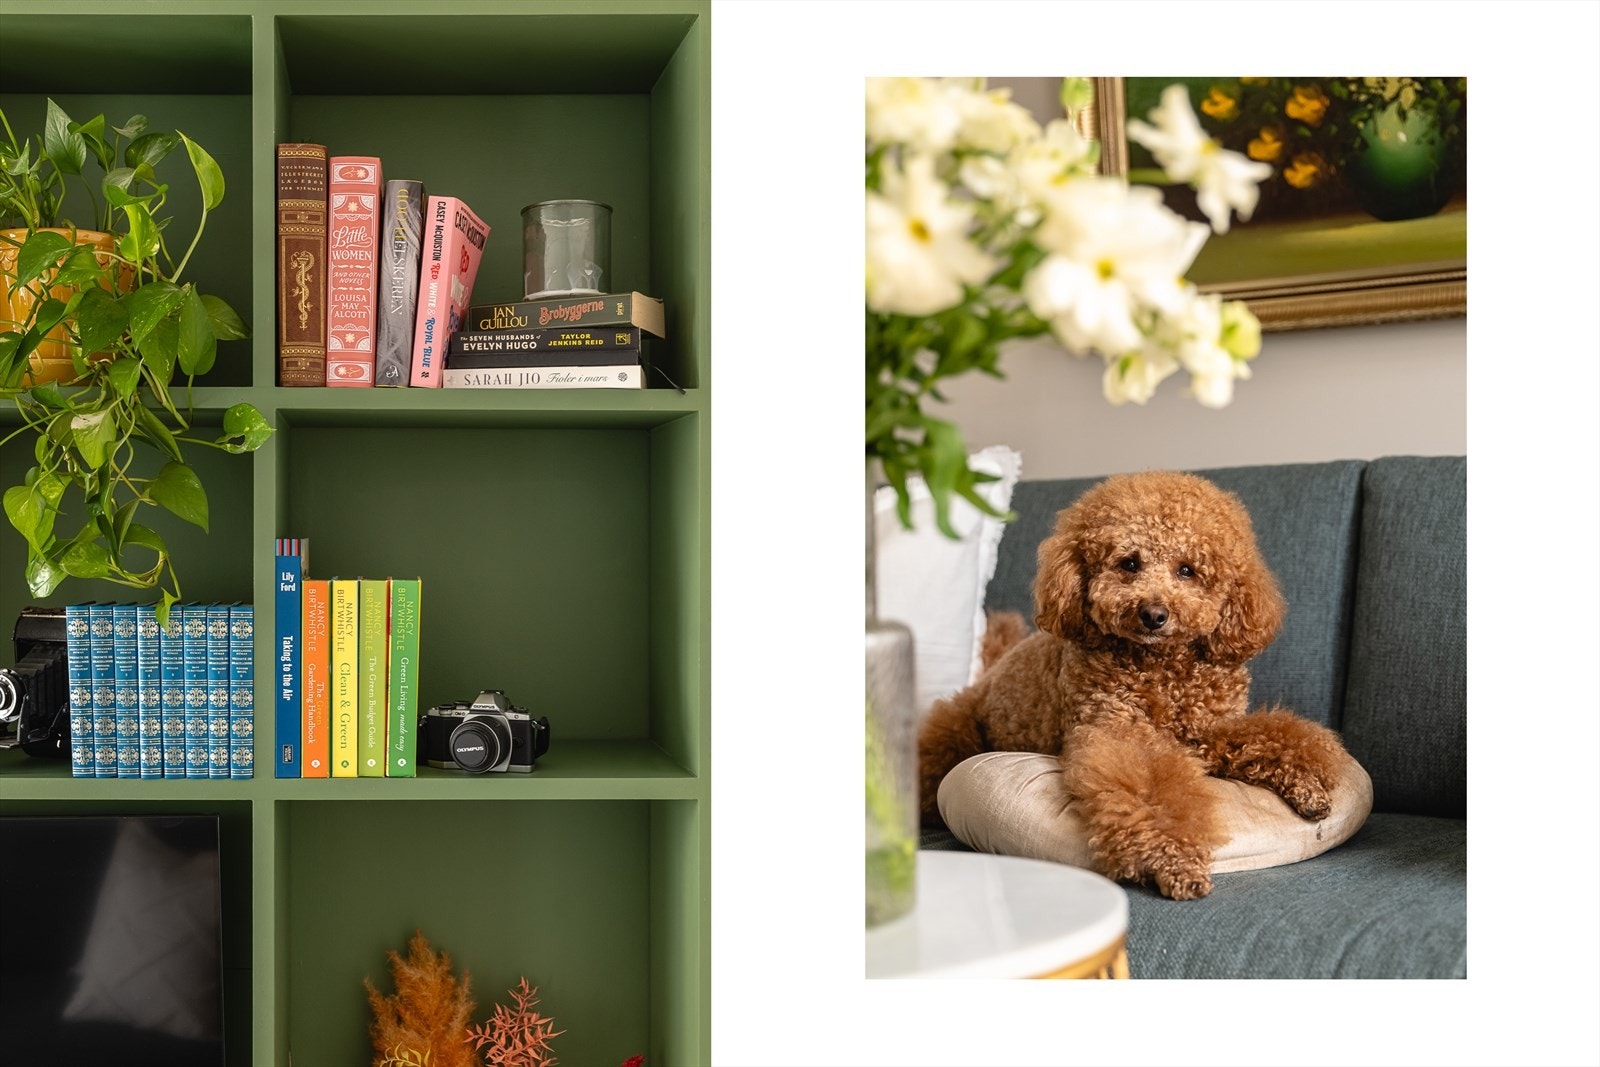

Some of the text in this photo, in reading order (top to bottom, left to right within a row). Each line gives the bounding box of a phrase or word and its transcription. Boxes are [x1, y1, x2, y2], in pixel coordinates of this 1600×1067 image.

[332, 225, 373, 249] Little
[432, 201, 447, 261] CASEY McQUISTON
[332, 250, 372, 261] WOMEN
[334, 294, 367, 302] LOUISA
[341, 302, 360, 310] MAY
[428, 282, 438, 307] WHITE
[427, 308, 436, 316] &
[480, 316, 528, 330] GUILLOU
[494, 306, 515, 319] JAN
[538, 300, 604, 325] Brobyggerne
[424, 317, 436, 344] ROYAL
[463, 341, 537, 351] EVELYN HUGO
[422, 345, 433, 368] BLUE
[464, 373, 512, 386] SARAH
[518, 372, 541, 387] JIO
[546, 372, 577, 383] Fioler
[280, 582, 296, 592] Ford
[281, 572, 295, 582] Lily
[308, 588, 317, 652] BIRTWHISTLE
[317, 601, 325, 636] NANCY
[337, 589, 345, 652] BIRTWHISTLE
[345, 602, 353, 637] NANCY
[365, 588, 374, 652] BIRTWHISTLE
[374, 601, 382, 636] NANCY
[396, 587, 406, 651] BIRTWHISTLE
[405, 601, 414, 636] NANCY
[281, 635, 294, 701] Taking to the Air
[306, 663, 316, 744] Gardening Handbook
[316, 682, 325, 725] The Green
[340, 662, 351, 749] Clean & Green
[366, 656, 377, 748] The Green Budget Guide
[395, 657, 409, 752] Green Living made easy
